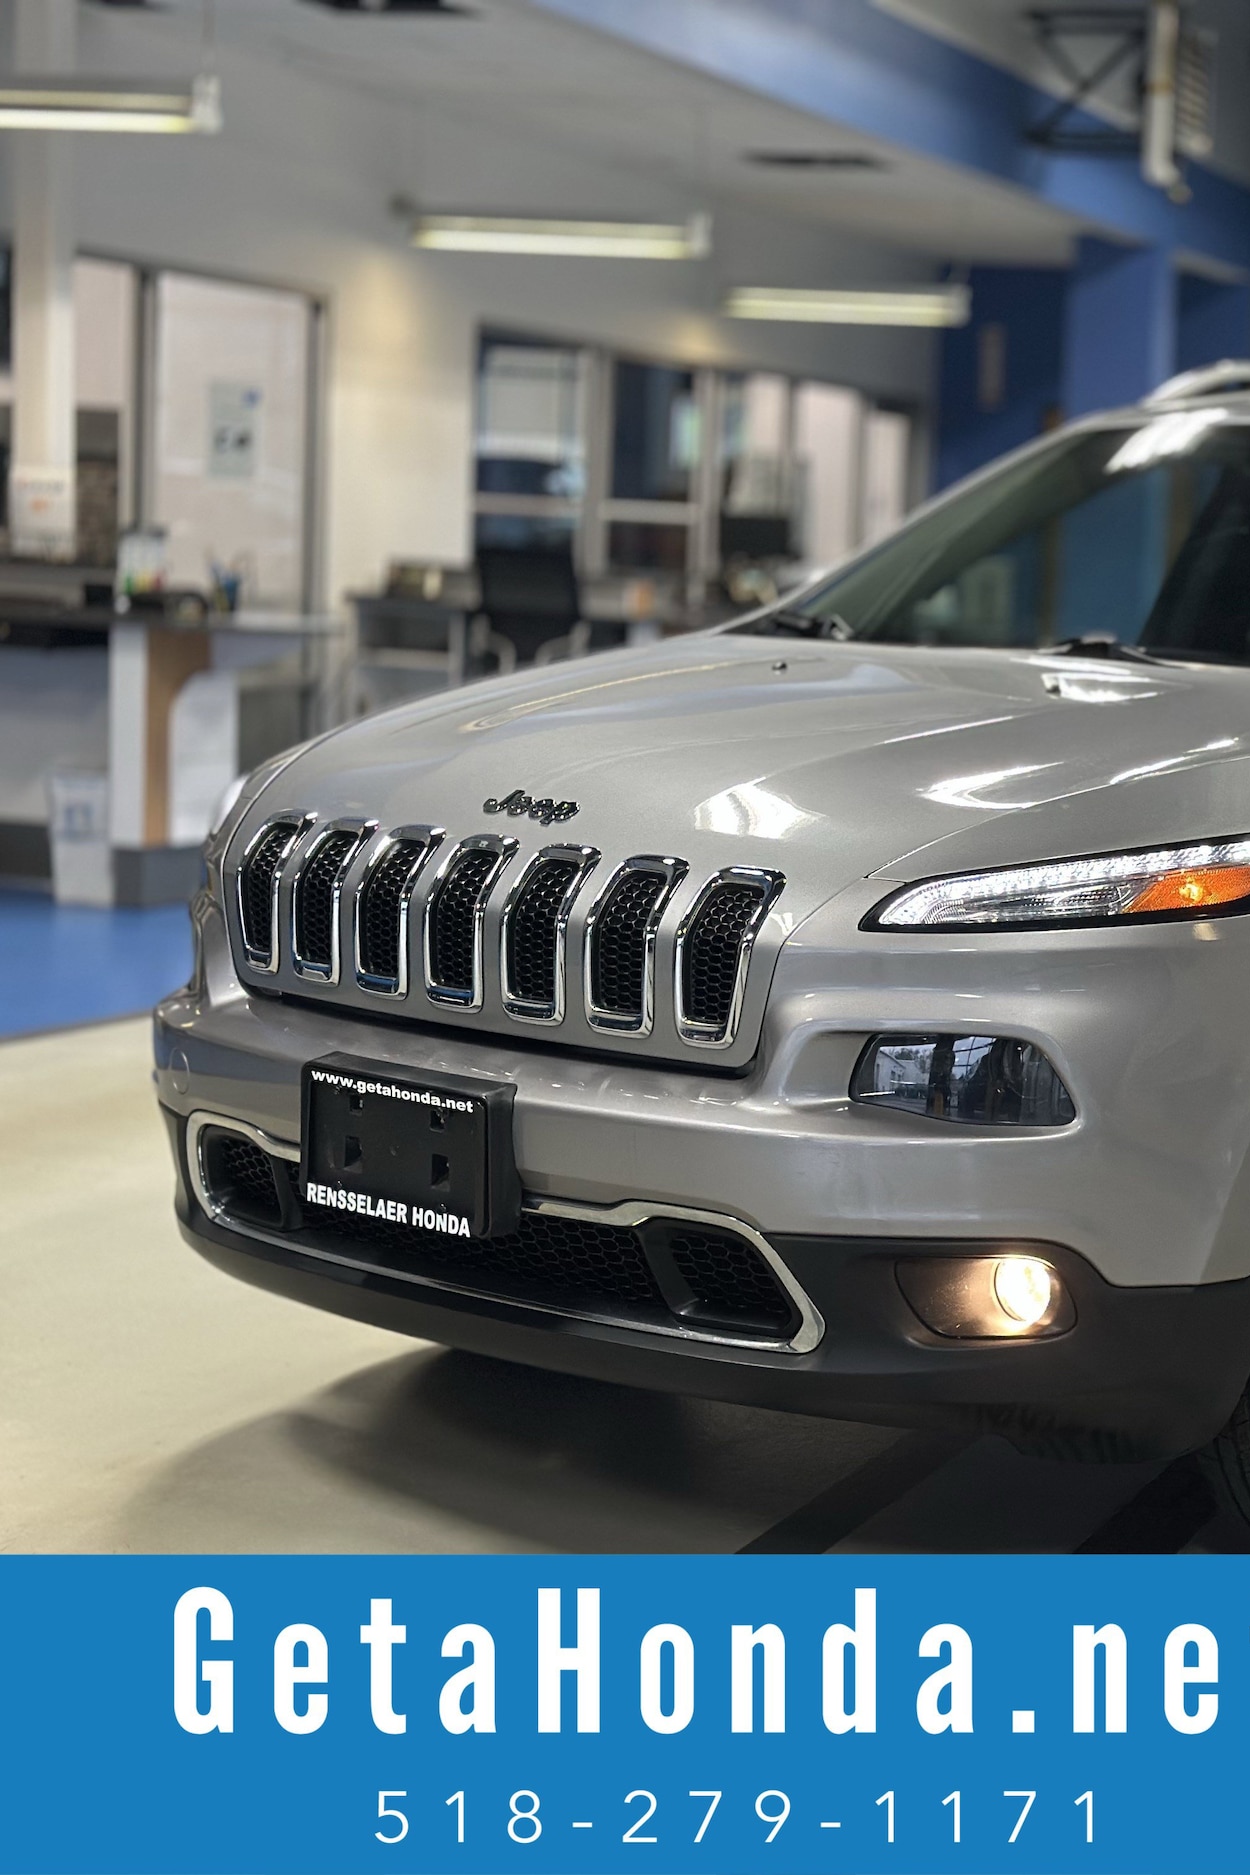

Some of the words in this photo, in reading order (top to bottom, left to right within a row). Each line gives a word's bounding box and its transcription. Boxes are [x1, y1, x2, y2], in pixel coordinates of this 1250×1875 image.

[483, 789, 580, 826] Jeep
[311, 1070, 474, 1113] www.getahonda.net
[306, 1182, 408, 1224] RENSSELAER
[412, 1206, 471, 1238] HONDA
